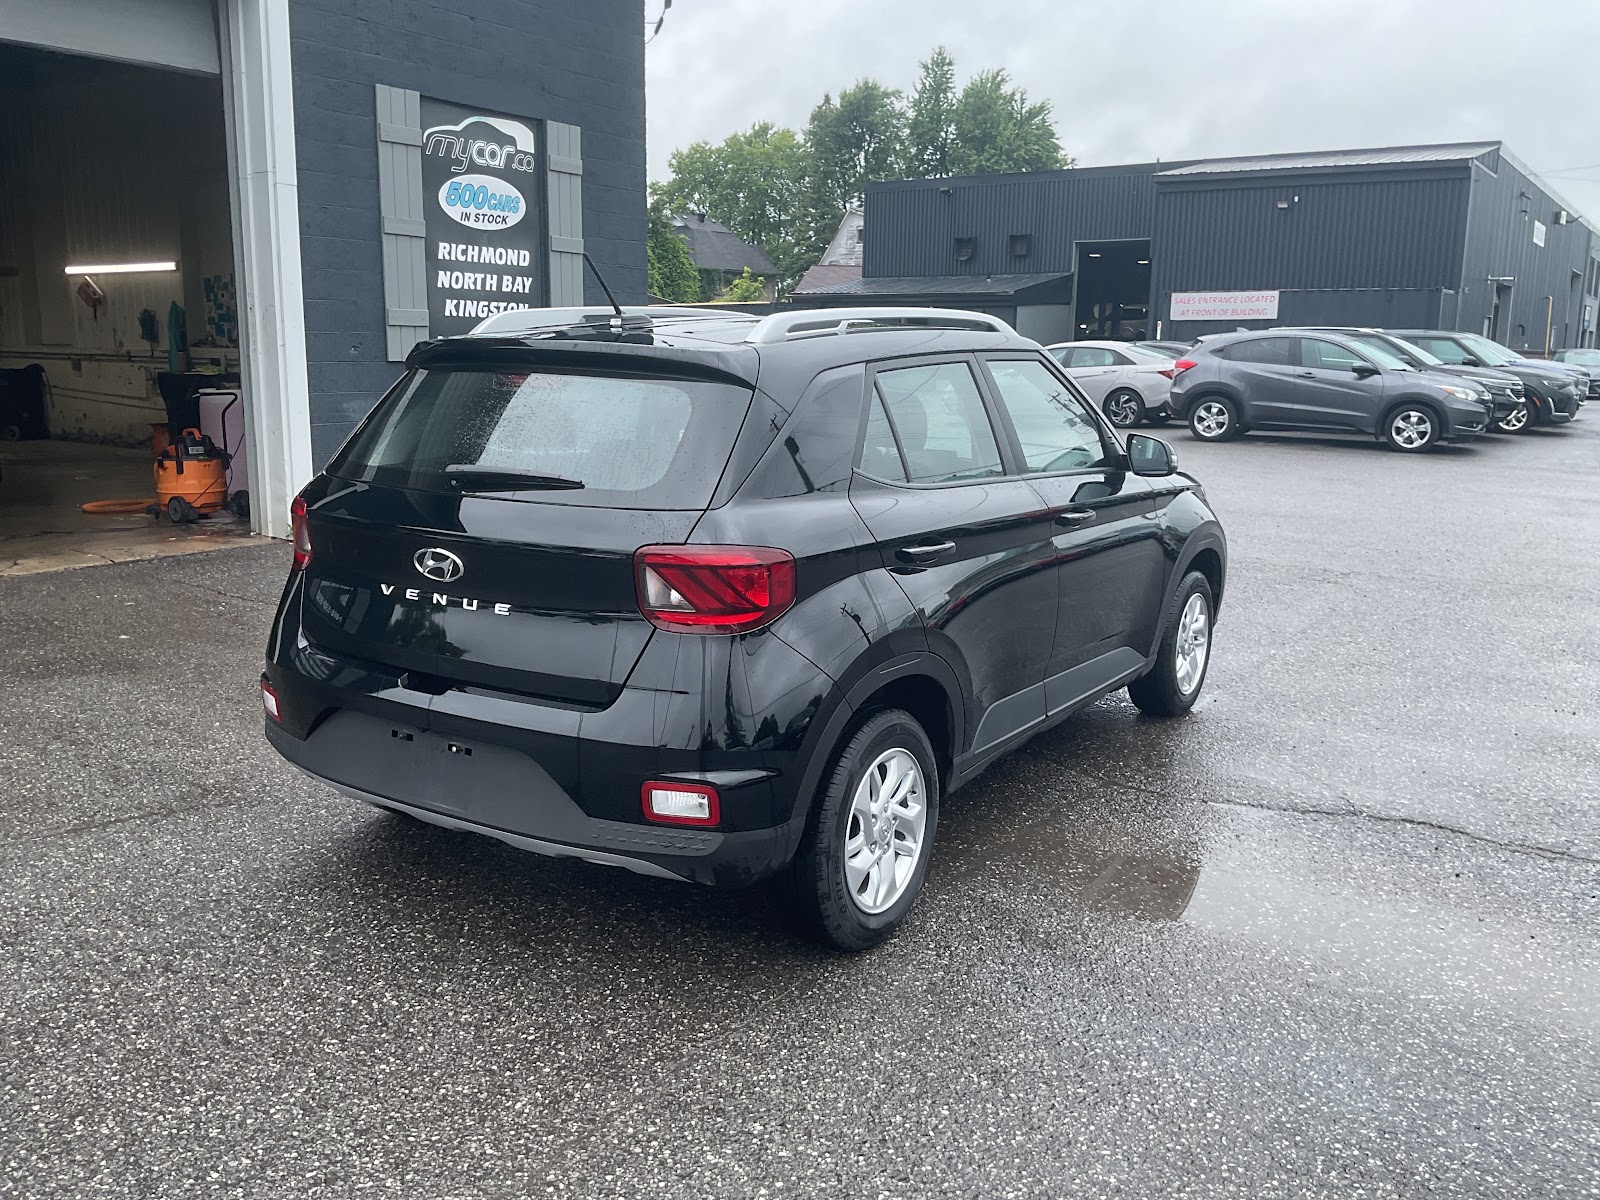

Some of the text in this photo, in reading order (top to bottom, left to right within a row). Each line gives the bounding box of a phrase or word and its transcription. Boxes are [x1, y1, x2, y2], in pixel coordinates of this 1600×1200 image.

[445, 181, 521, 214] 500 CARS
[460, 211, 509, 225] IN STOCK
[437, 242, 530, 267] RICHMOND
[437, 270, 533, 293] NORTH BAY
[1174, 295, 1276, 305] SALES ENTRANCE LOCATED
[1191, 309, 1217, 317] FRONT
[1218, 308, 1230, 316] OF
[1230, 308, 1268, 316] BUILDING
[380, 583, 512, 616] VENUE
